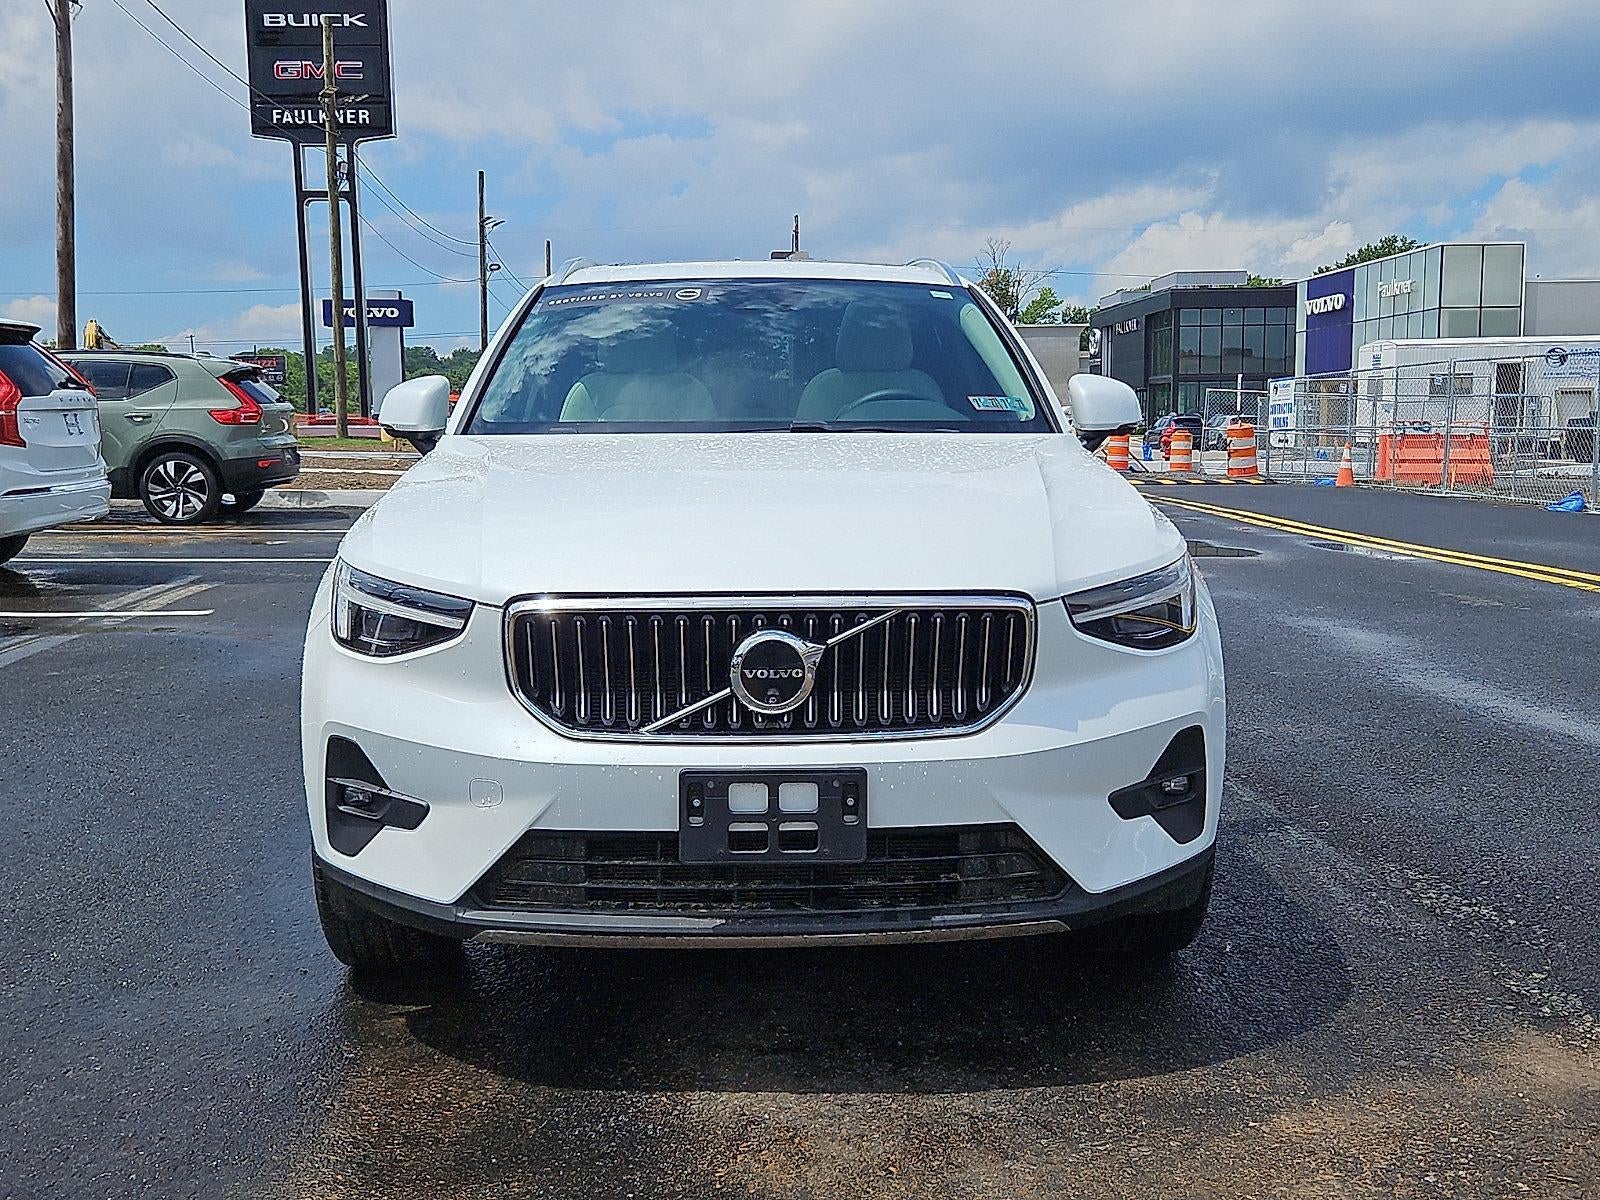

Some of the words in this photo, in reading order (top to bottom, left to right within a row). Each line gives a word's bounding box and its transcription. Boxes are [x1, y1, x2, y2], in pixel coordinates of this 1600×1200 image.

[263, 13, 368, 27] BUICK
[274, 60, 363, 80] GMC
[272, 109, 370, 124] FAULKNER
[1378, 280, 1412, 298] Faulkner
[548, 294, 606, 306] CERTIFIED
[1305, 294, 1345, 316] VOLVO
[742, 669, 804, 679] VOLVO
